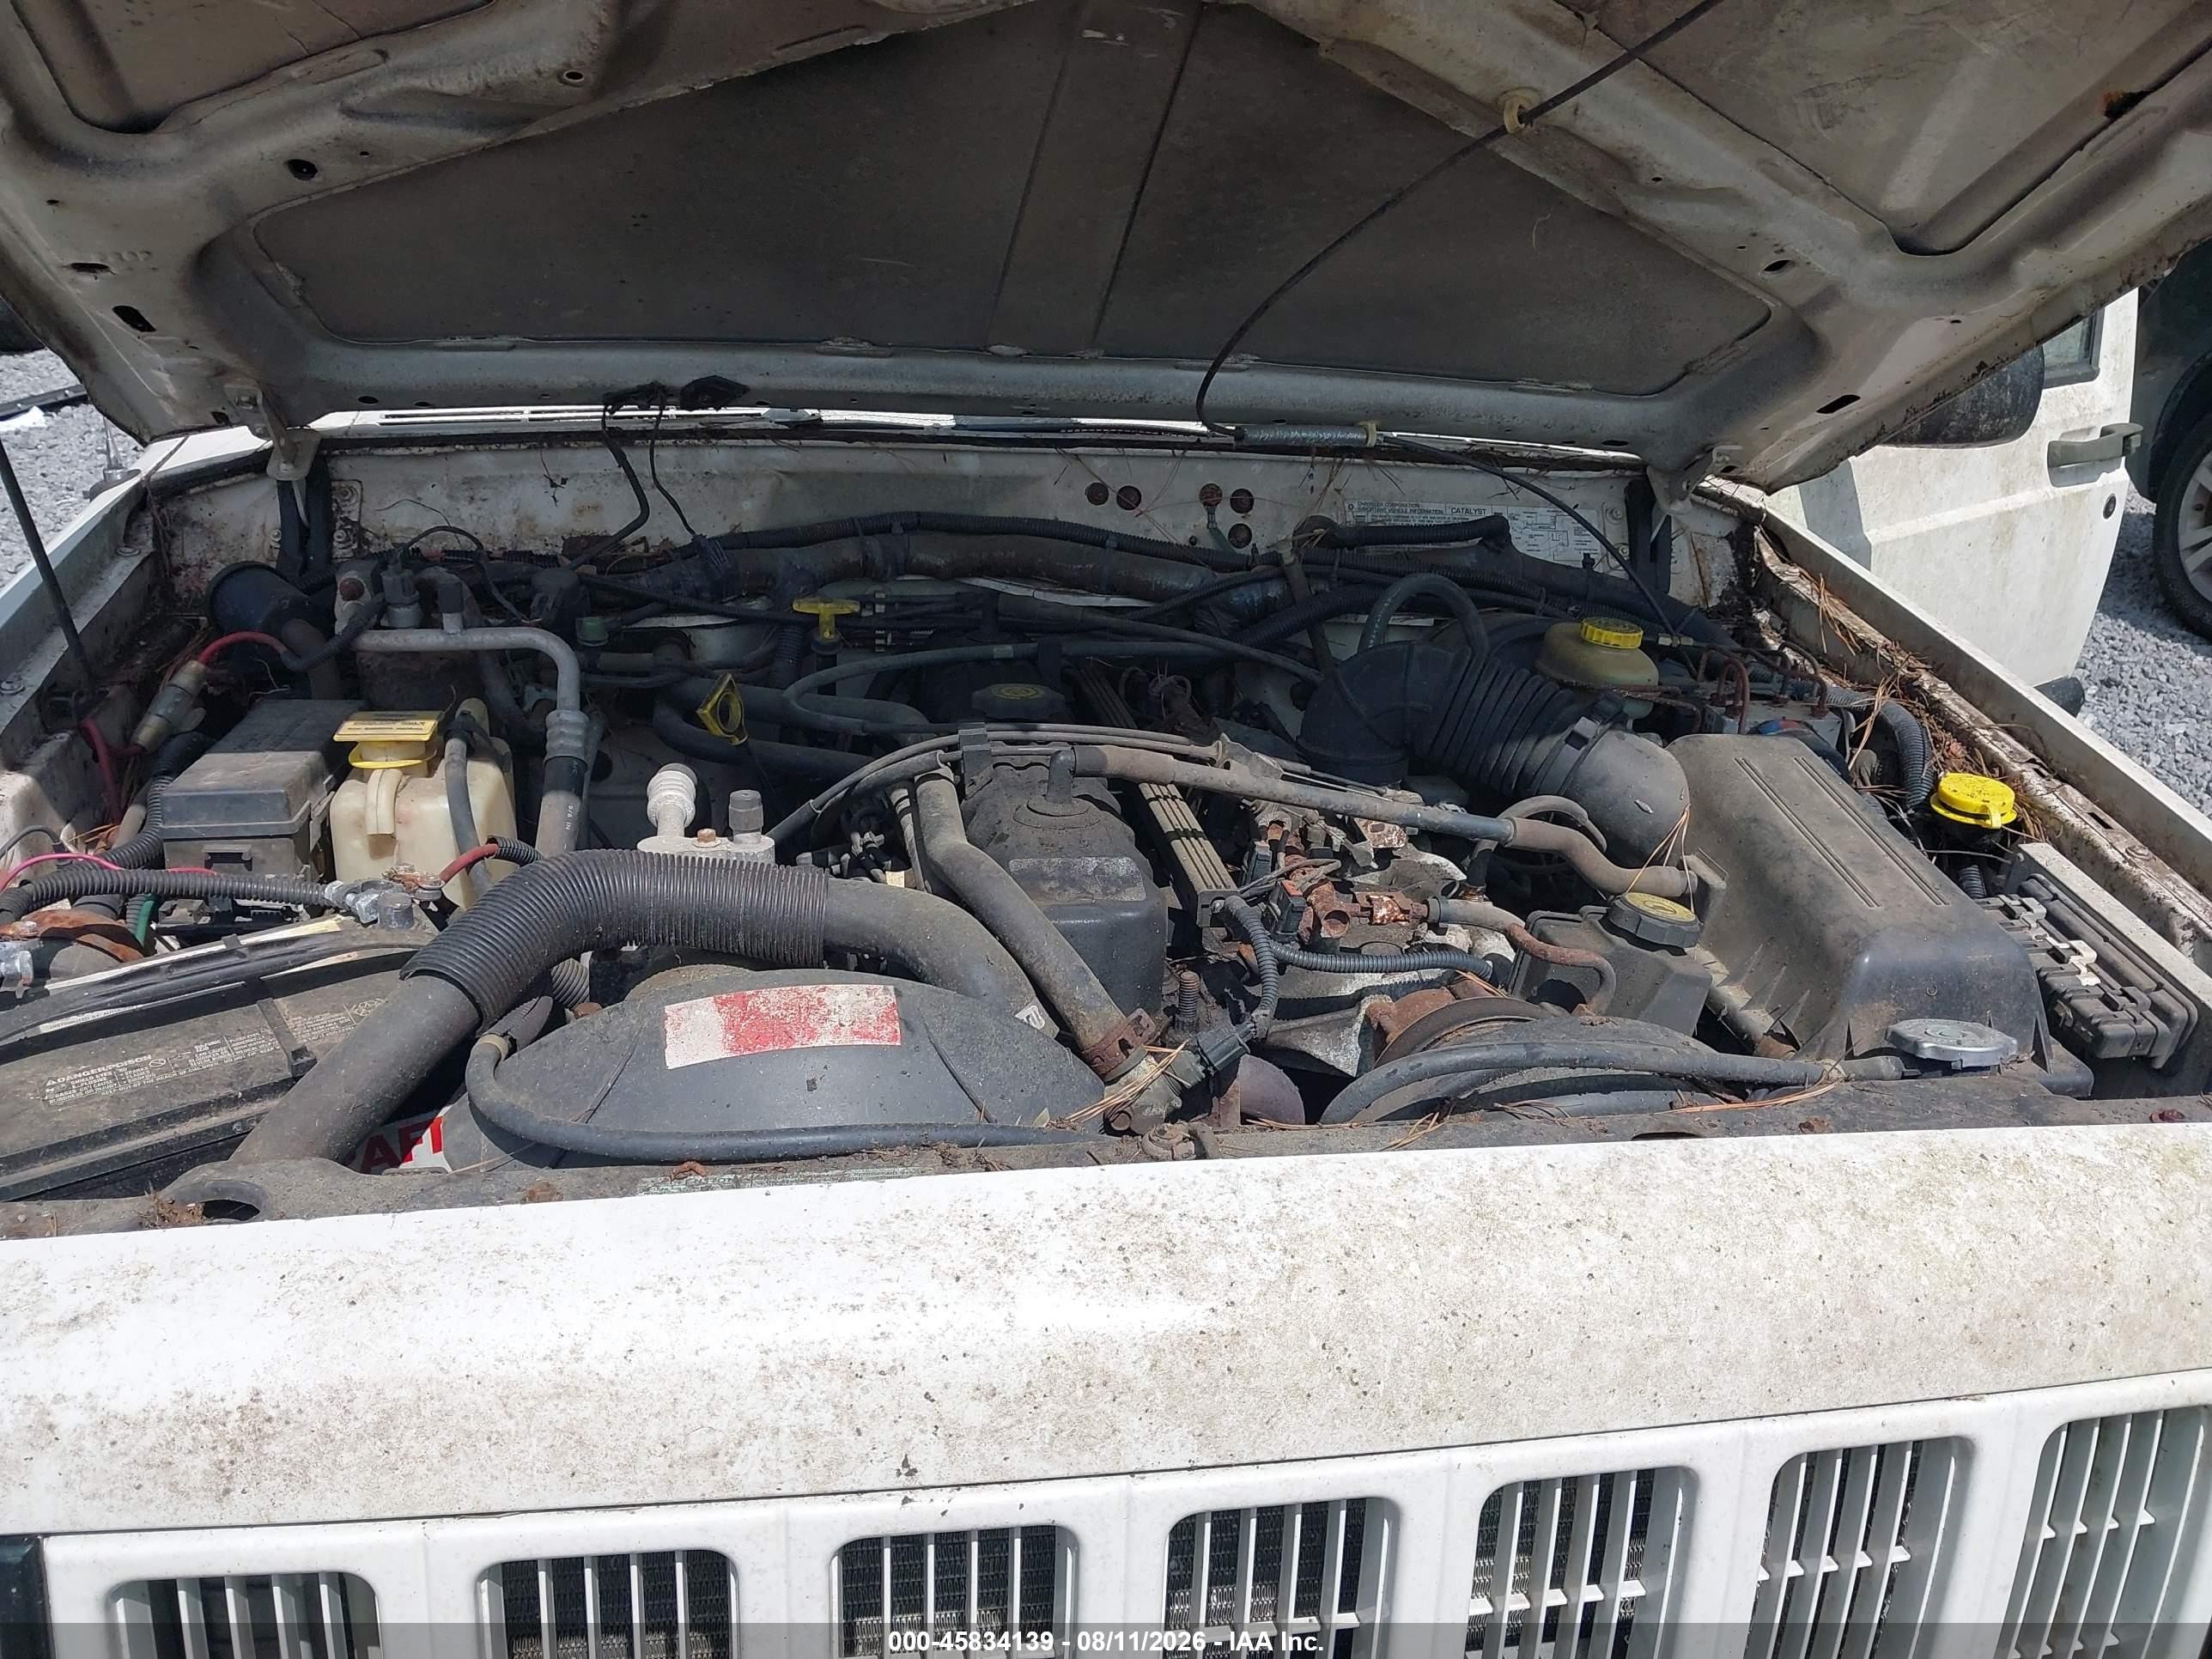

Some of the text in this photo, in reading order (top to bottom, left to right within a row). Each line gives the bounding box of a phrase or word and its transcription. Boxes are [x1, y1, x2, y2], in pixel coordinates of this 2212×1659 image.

[1450, 507, 1487, 515] CATALYST
[57, 1054, 152, 1083] DANGER/POISON
[72, 1077, 108, 1090] EPLOSIVE
